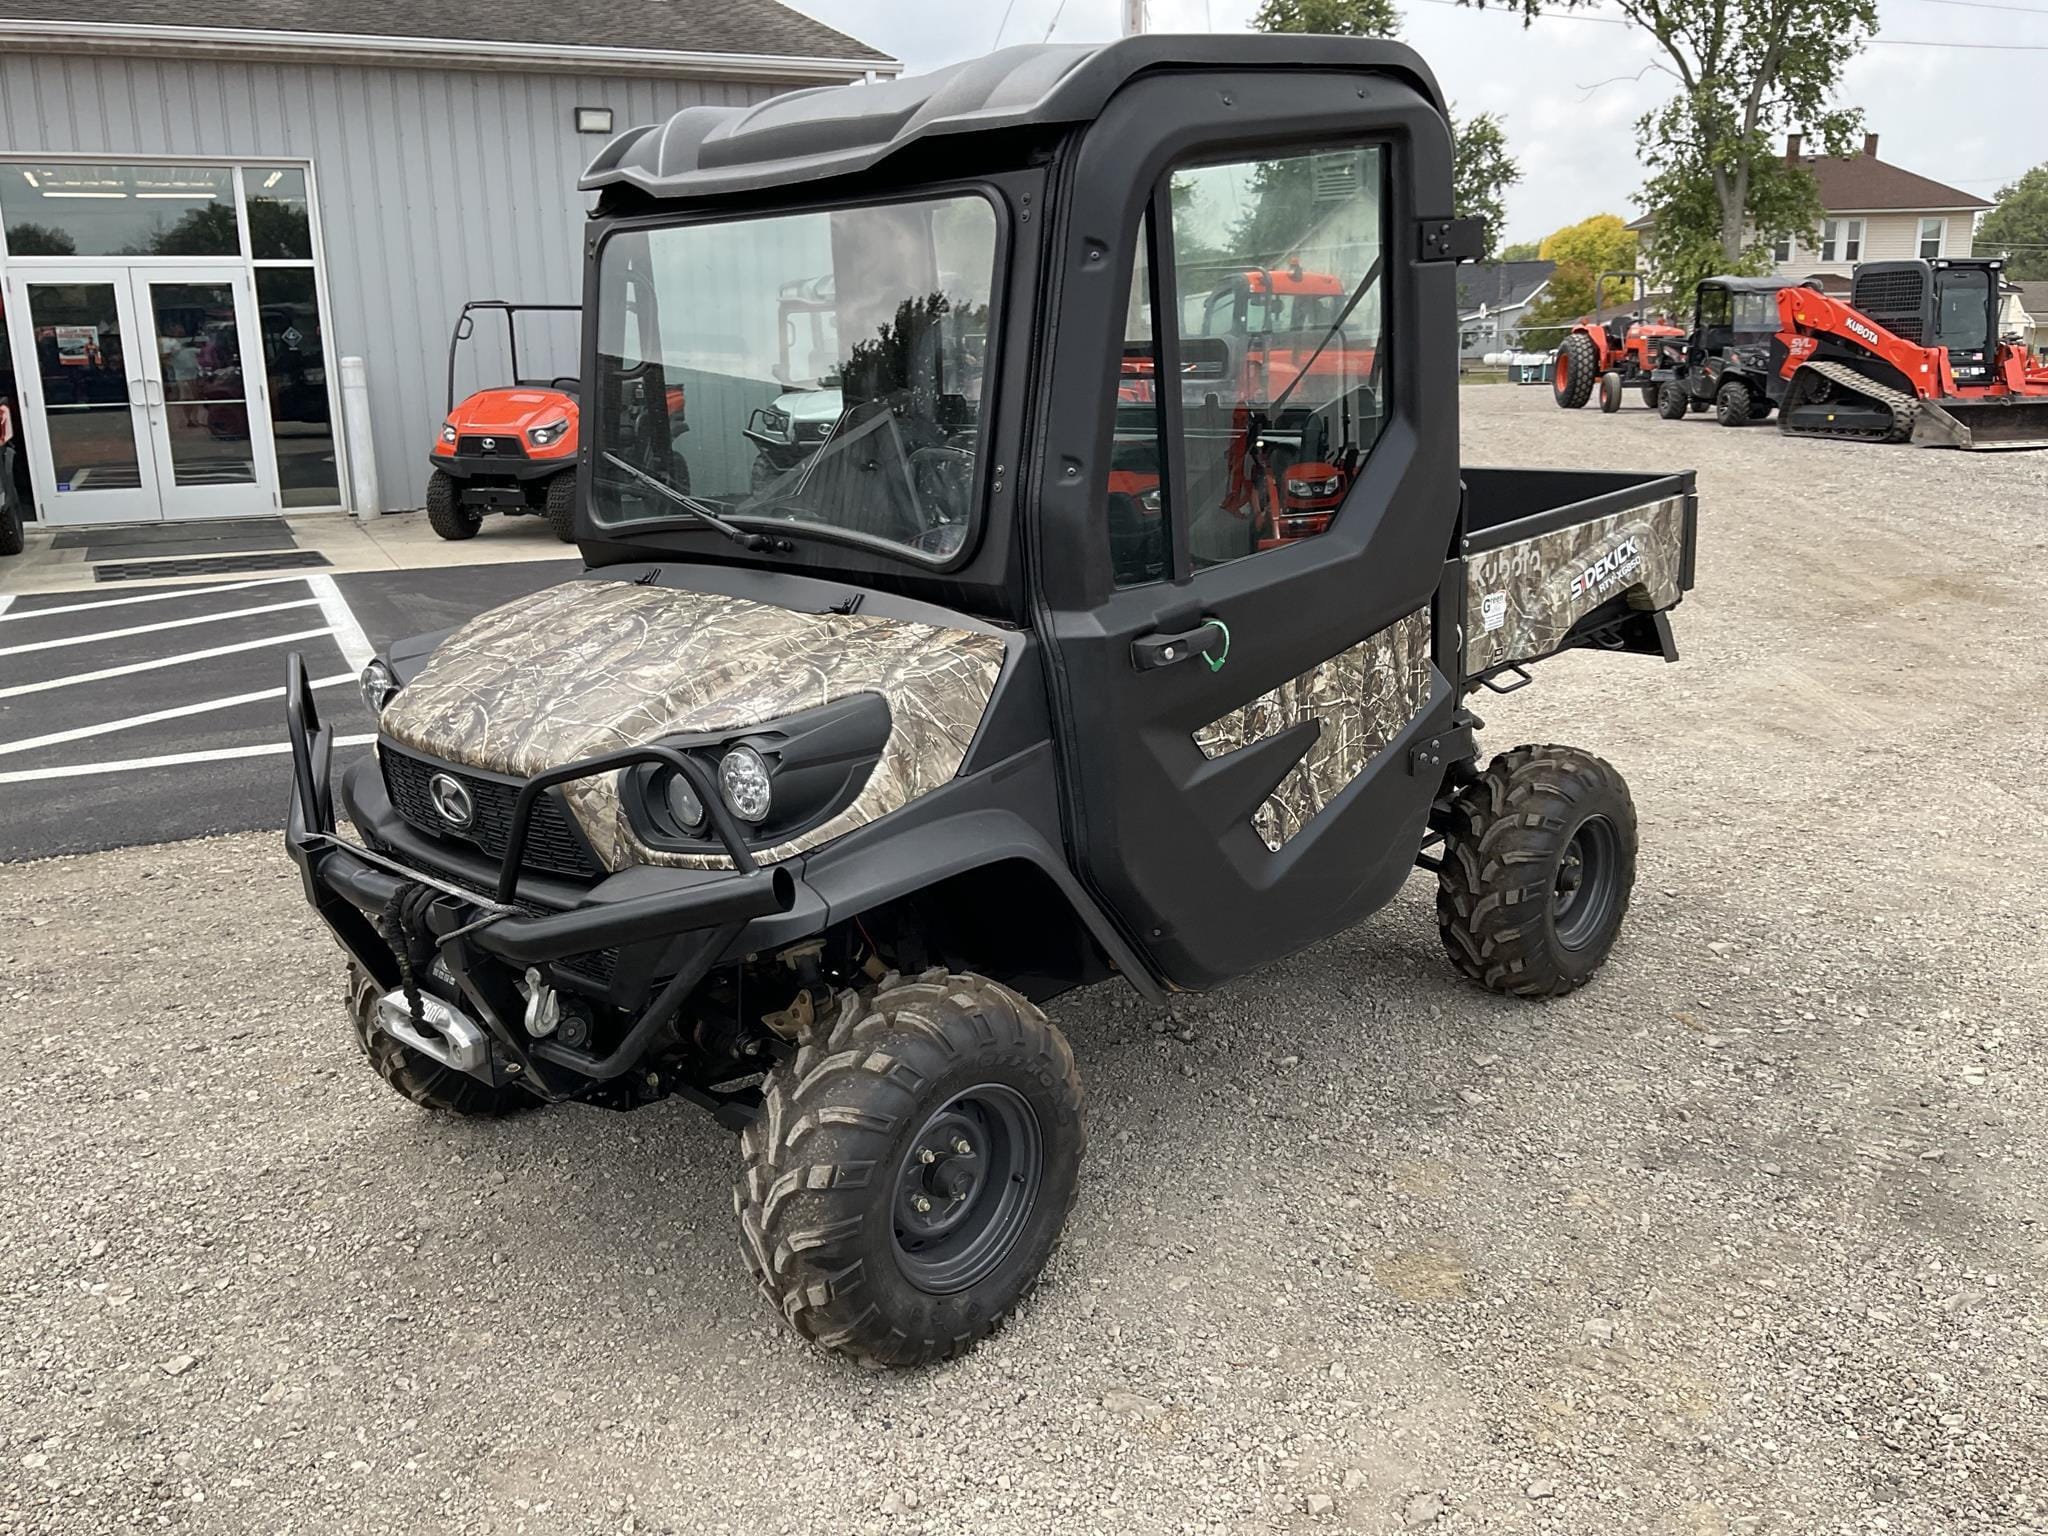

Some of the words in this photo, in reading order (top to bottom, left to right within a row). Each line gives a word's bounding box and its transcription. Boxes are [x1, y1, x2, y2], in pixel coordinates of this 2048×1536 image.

[1845, 316, 1879, 345] KUBOTA
[1472, 540, 1541, 588] Kubota
[1570, 535, 1638, 601] SIDEKICK
